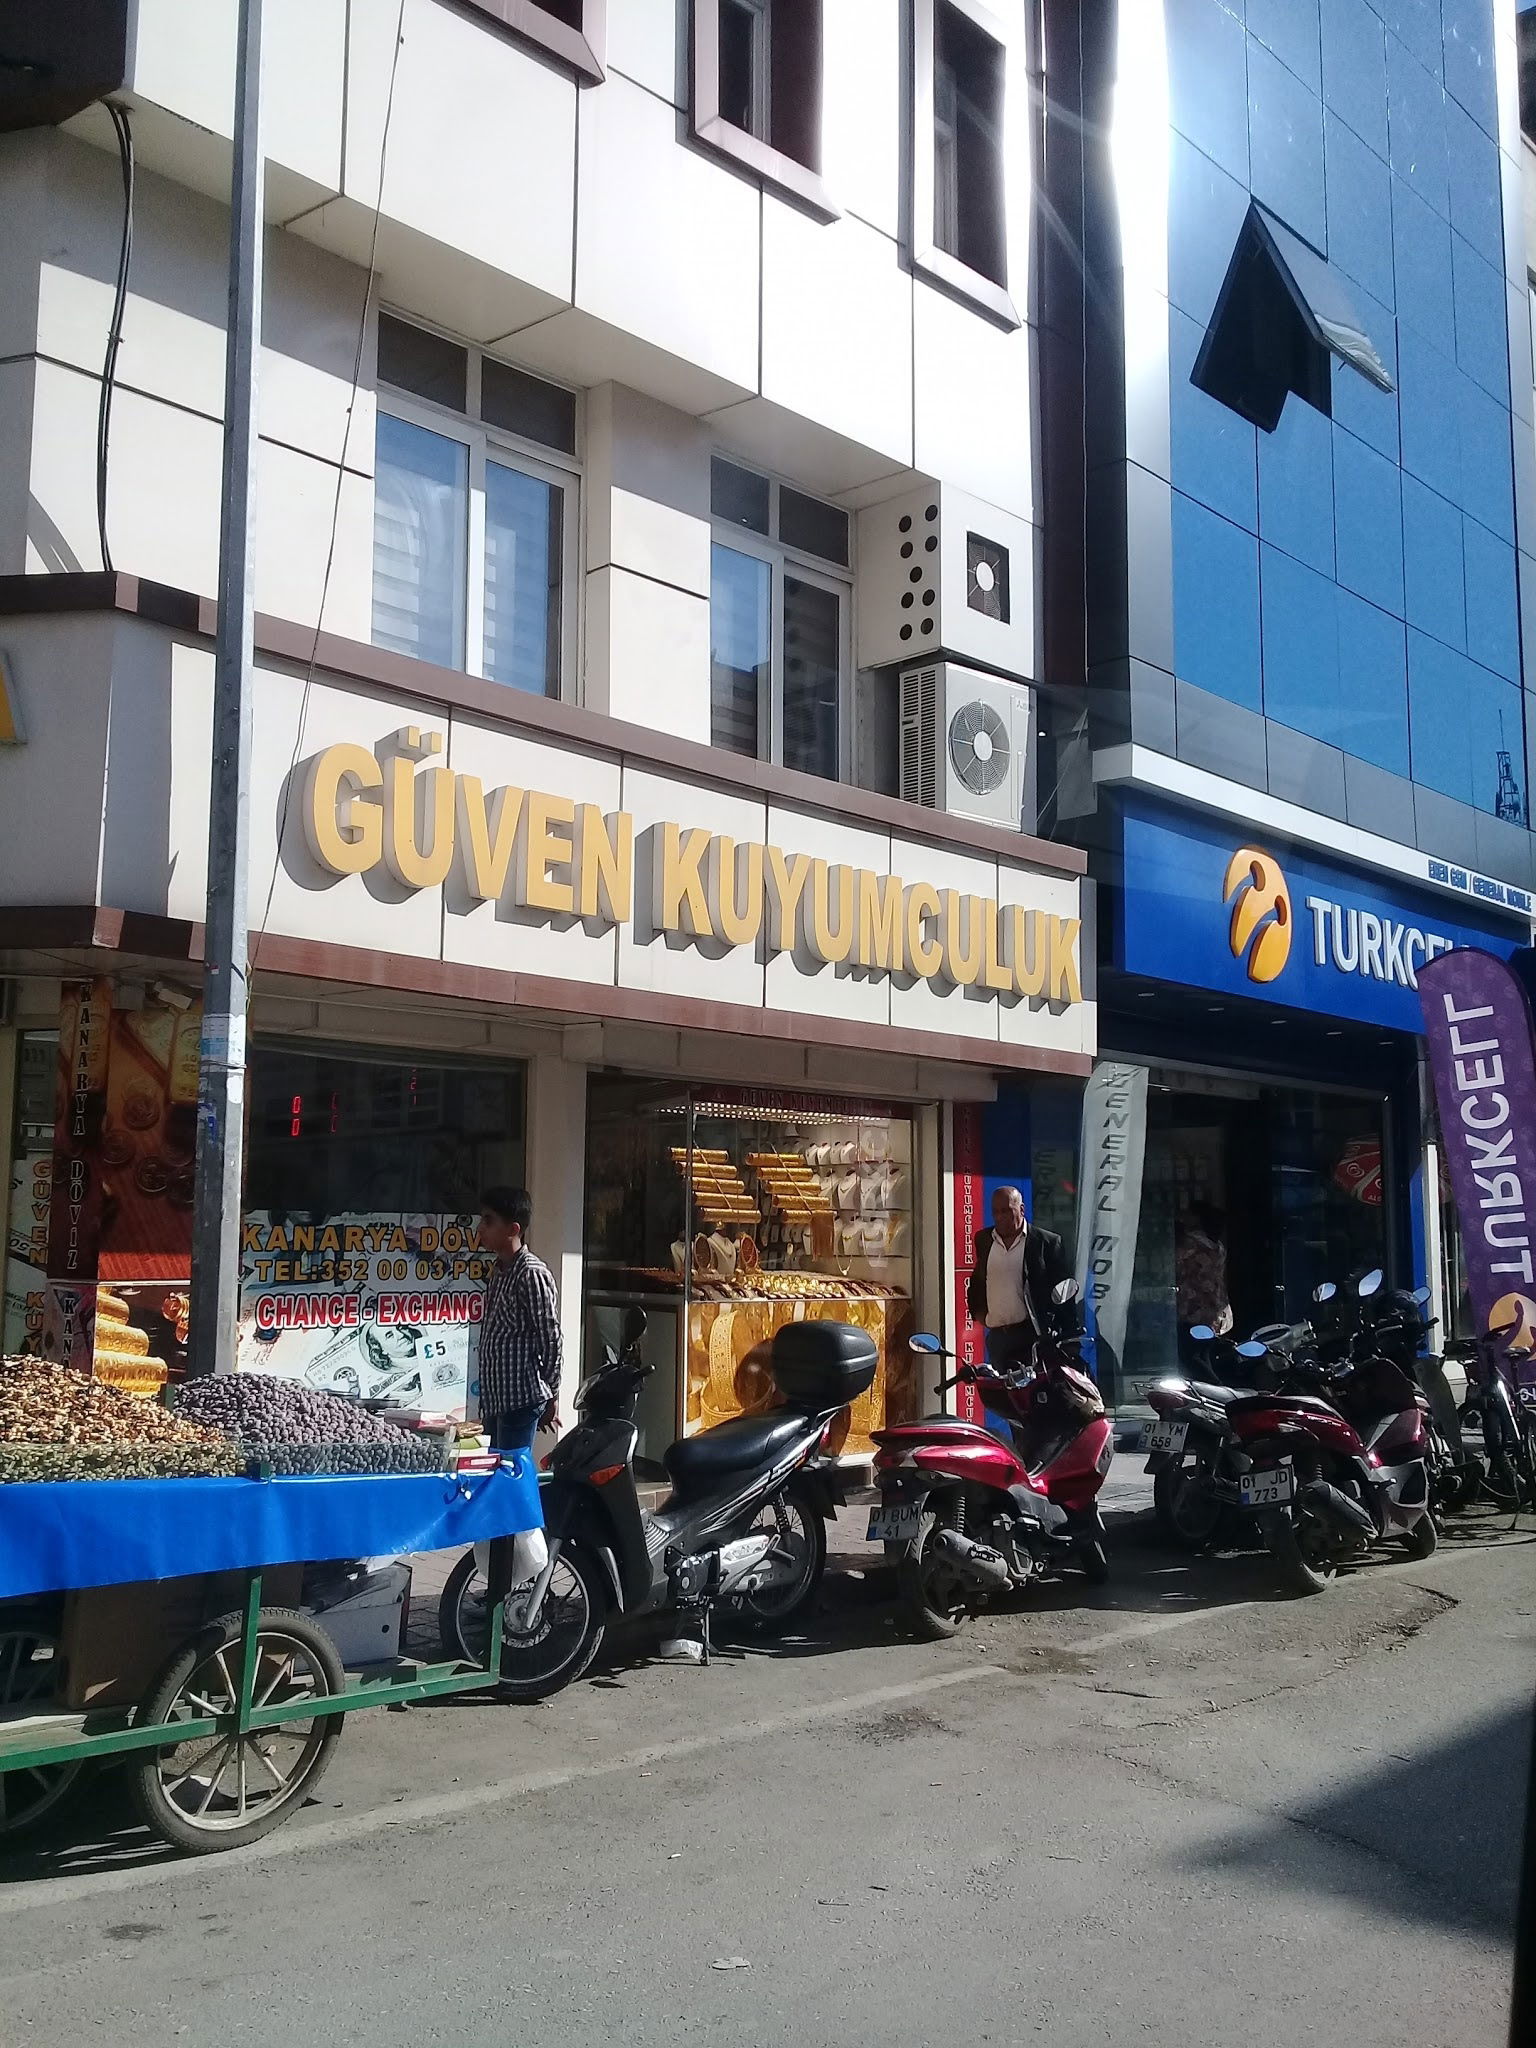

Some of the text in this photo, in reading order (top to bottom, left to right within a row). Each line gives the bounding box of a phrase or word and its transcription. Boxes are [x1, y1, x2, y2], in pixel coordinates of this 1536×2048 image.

[303, 725, 1084, 1004] GÜVEN KUYUMCULUK
[1307, 896, 1469, 992] TURKC
[73, 983, 93, 1136] KANARYA
[29, 1161, 51, 1264] GÜVEN
[243, 1221, 482, 1252] KANARYA DÖV
[377, 1259, 407, 1280] 00
[416, 1258, 446, 1280] 03
[256, 1292, 360, 1330] CHANCE
[376, 1290, 487, 1328] EXCHANG
[1144, 1423, 1157, 1434] 01
[1150, 1436, 1172, 1448] 658
[1242, 1470, 1288, 1489] 01 JD
[1254, 1487, 1278, 1502] 773
